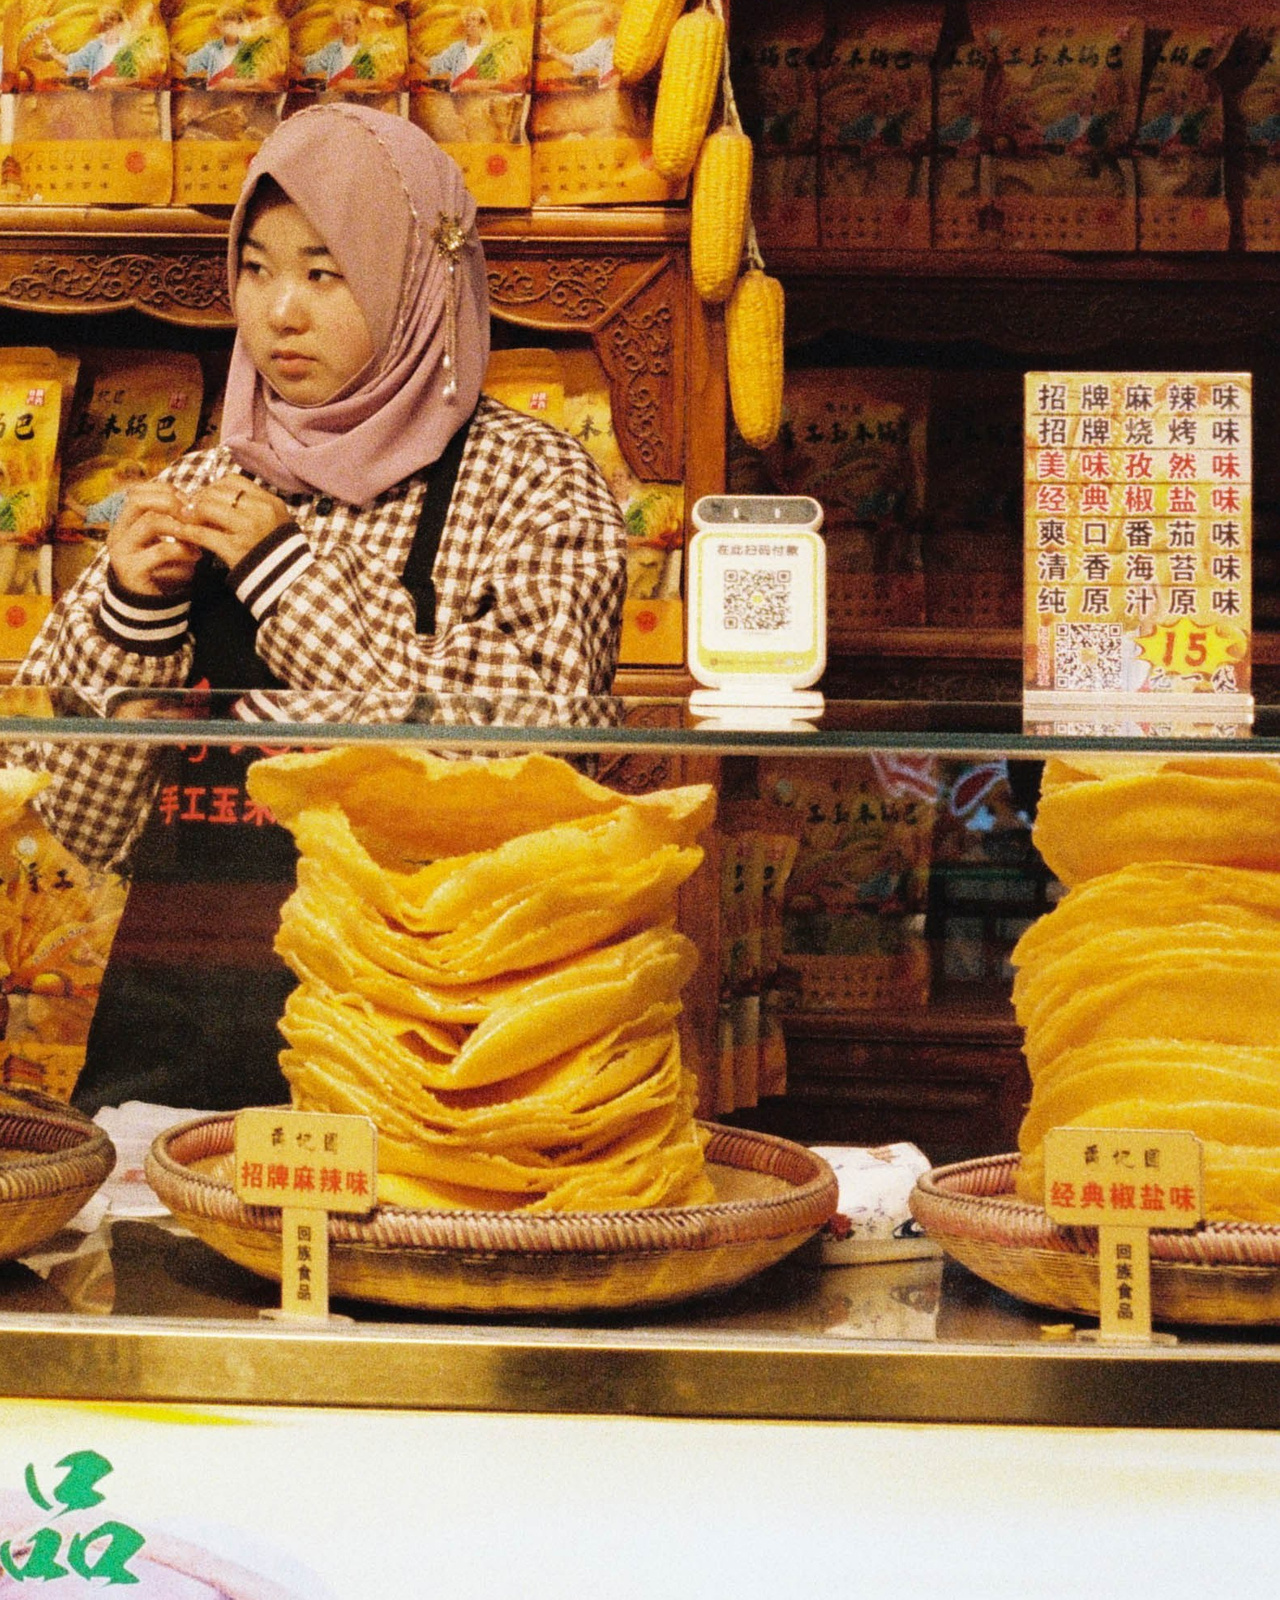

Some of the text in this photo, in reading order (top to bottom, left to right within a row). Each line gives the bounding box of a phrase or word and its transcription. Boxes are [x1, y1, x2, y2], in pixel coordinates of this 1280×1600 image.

[1038, 384, 1240, 411] 招牌麻辣味
[1038, 418, 1240, 445] 招牌烧烤味
[1038, 452, 1240, 479] 美味孜然味
[1038, 486, 1240, 513] 经典椒盐味
[1038, 520, 1240, 547] 爽口番茄味
[1038, 554, 1240, 581] 清香海苔味
[1038, 587, 1240, 615] 纯原汁原味
[1162, 631, 1208, 667] 15
[242, 1161, 368, 1197] 招牌麻辣味
[1050, 1181, 1196, 1212] 经典椒盐味
[298, 1226, 312, 1301] 回族食品
[1116, 1244, 1133, 1320] 回族食品
